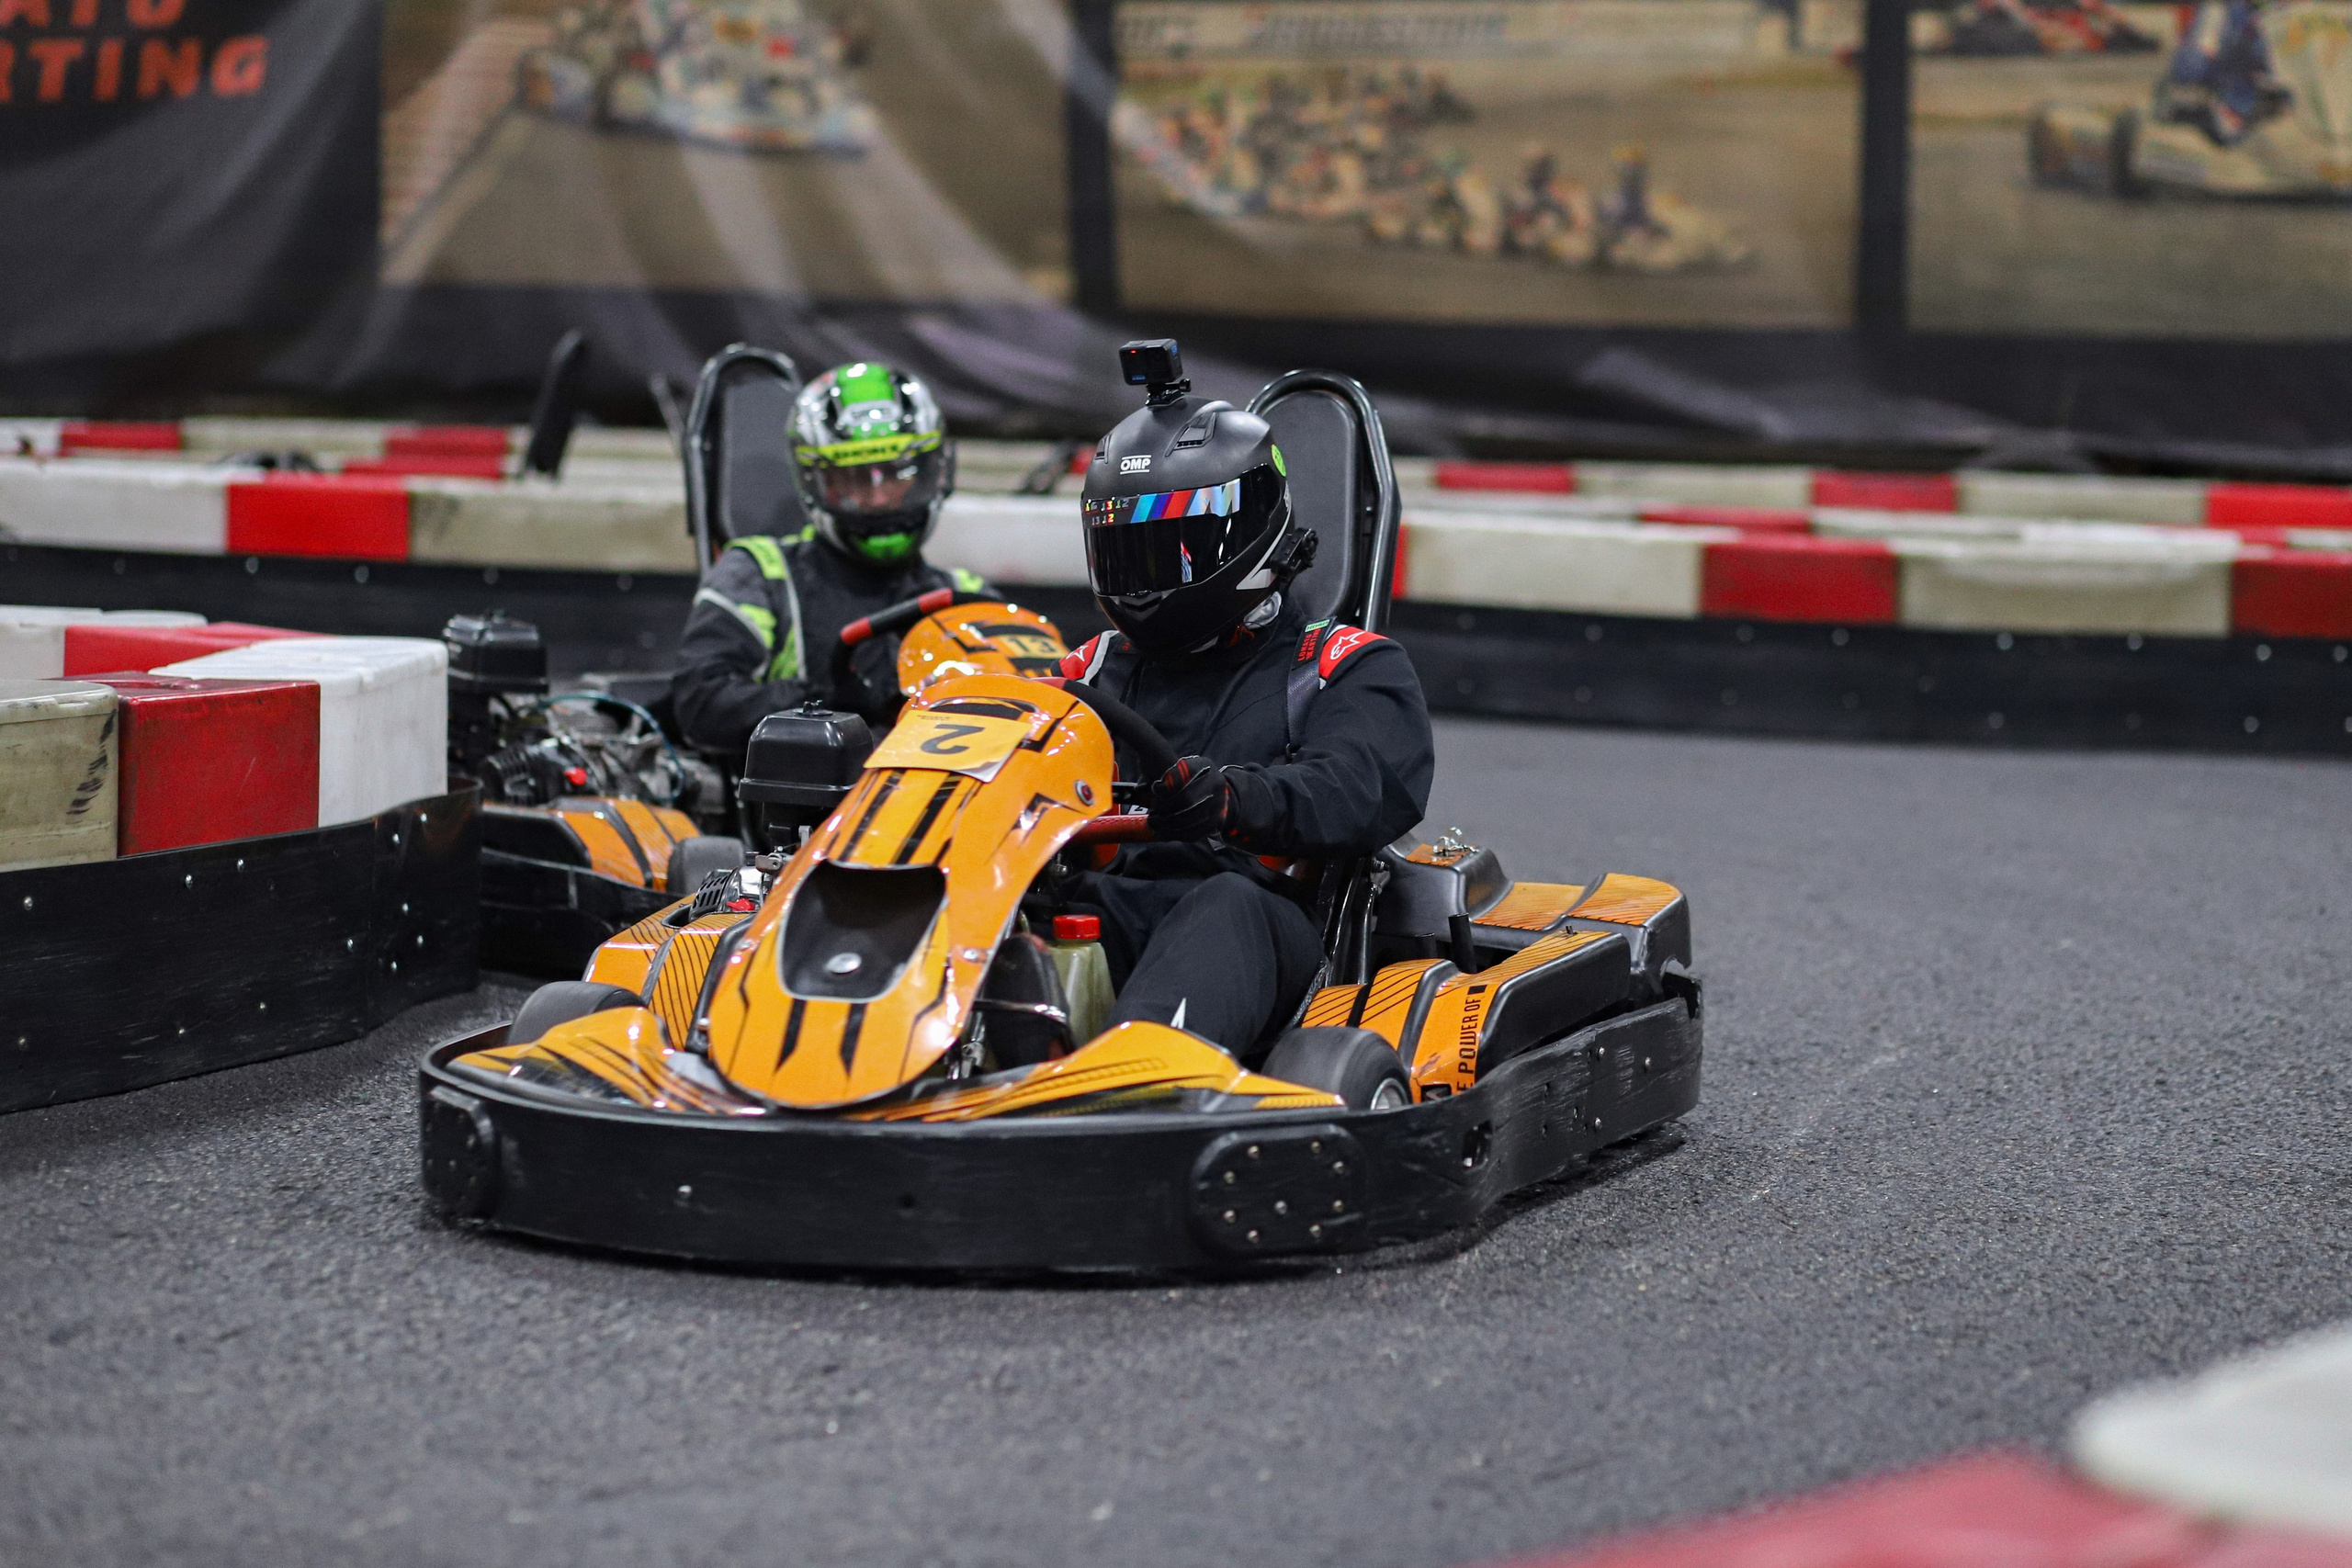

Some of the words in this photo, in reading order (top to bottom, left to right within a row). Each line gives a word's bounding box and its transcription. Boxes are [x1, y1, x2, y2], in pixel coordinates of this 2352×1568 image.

[0, 34, 269, 103] TING
[1120, 457, 1151, 471] OMP
[920, 724, 986, 755] 2
[1464, 998, 1482, 1012] OF
[1458, 1014, 1479, 1074] POWER
